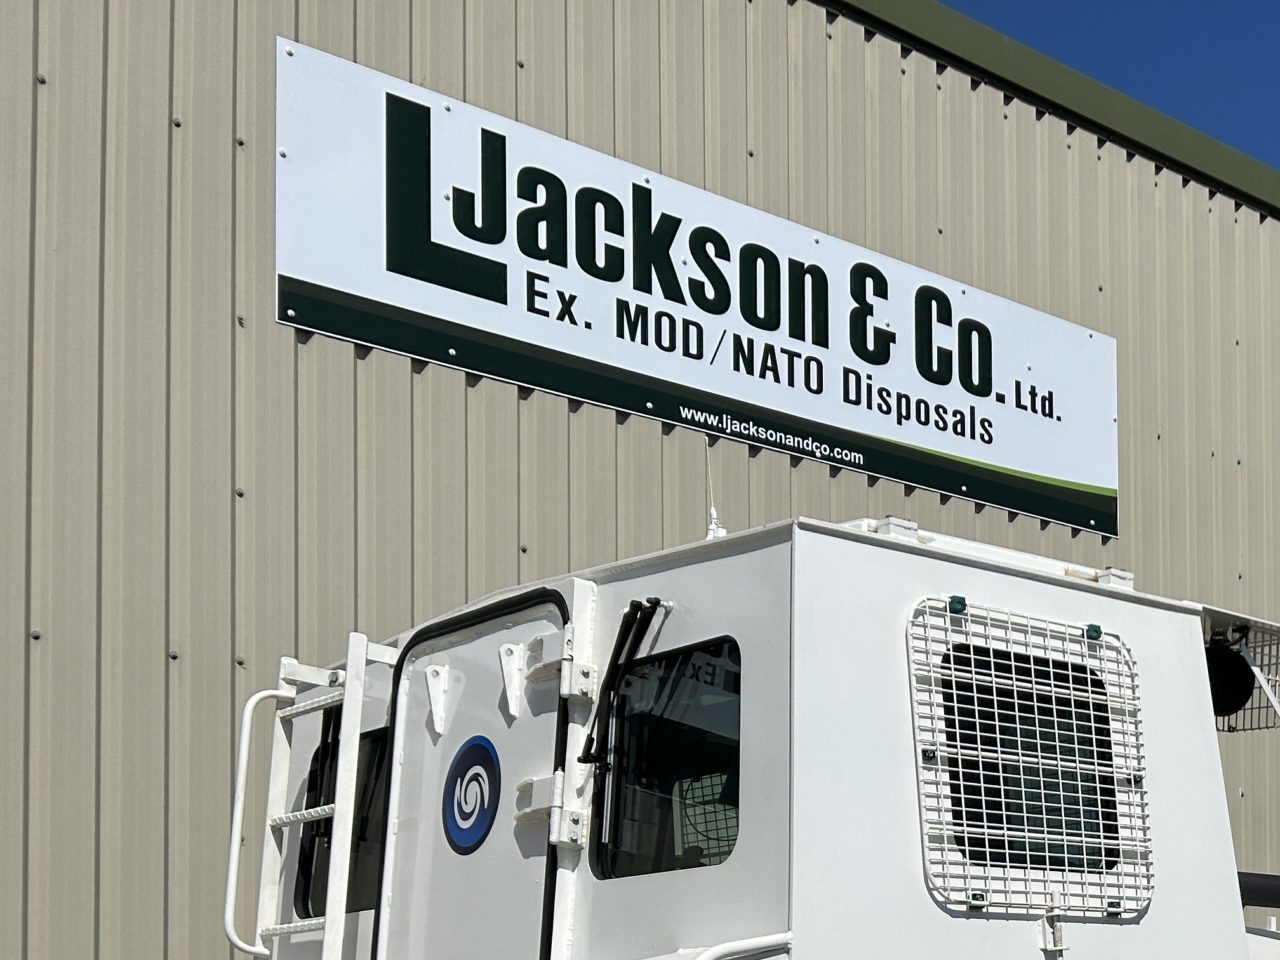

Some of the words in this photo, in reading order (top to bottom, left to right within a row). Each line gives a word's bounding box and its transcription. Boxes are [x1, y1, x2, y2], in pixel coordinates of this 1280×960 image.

[526, 270, 592, 330] Ex.
[616, 297, 824, 395] MOD/NATO
[842, 366, 994, 445] Disposals
[849, 262, 897, 365] &
[915, 285, 1006, 404] Co.
[1015, 380, 1062, 422] Ltd.
[679, 396, 864, 465] www.ljacksonandco.com
